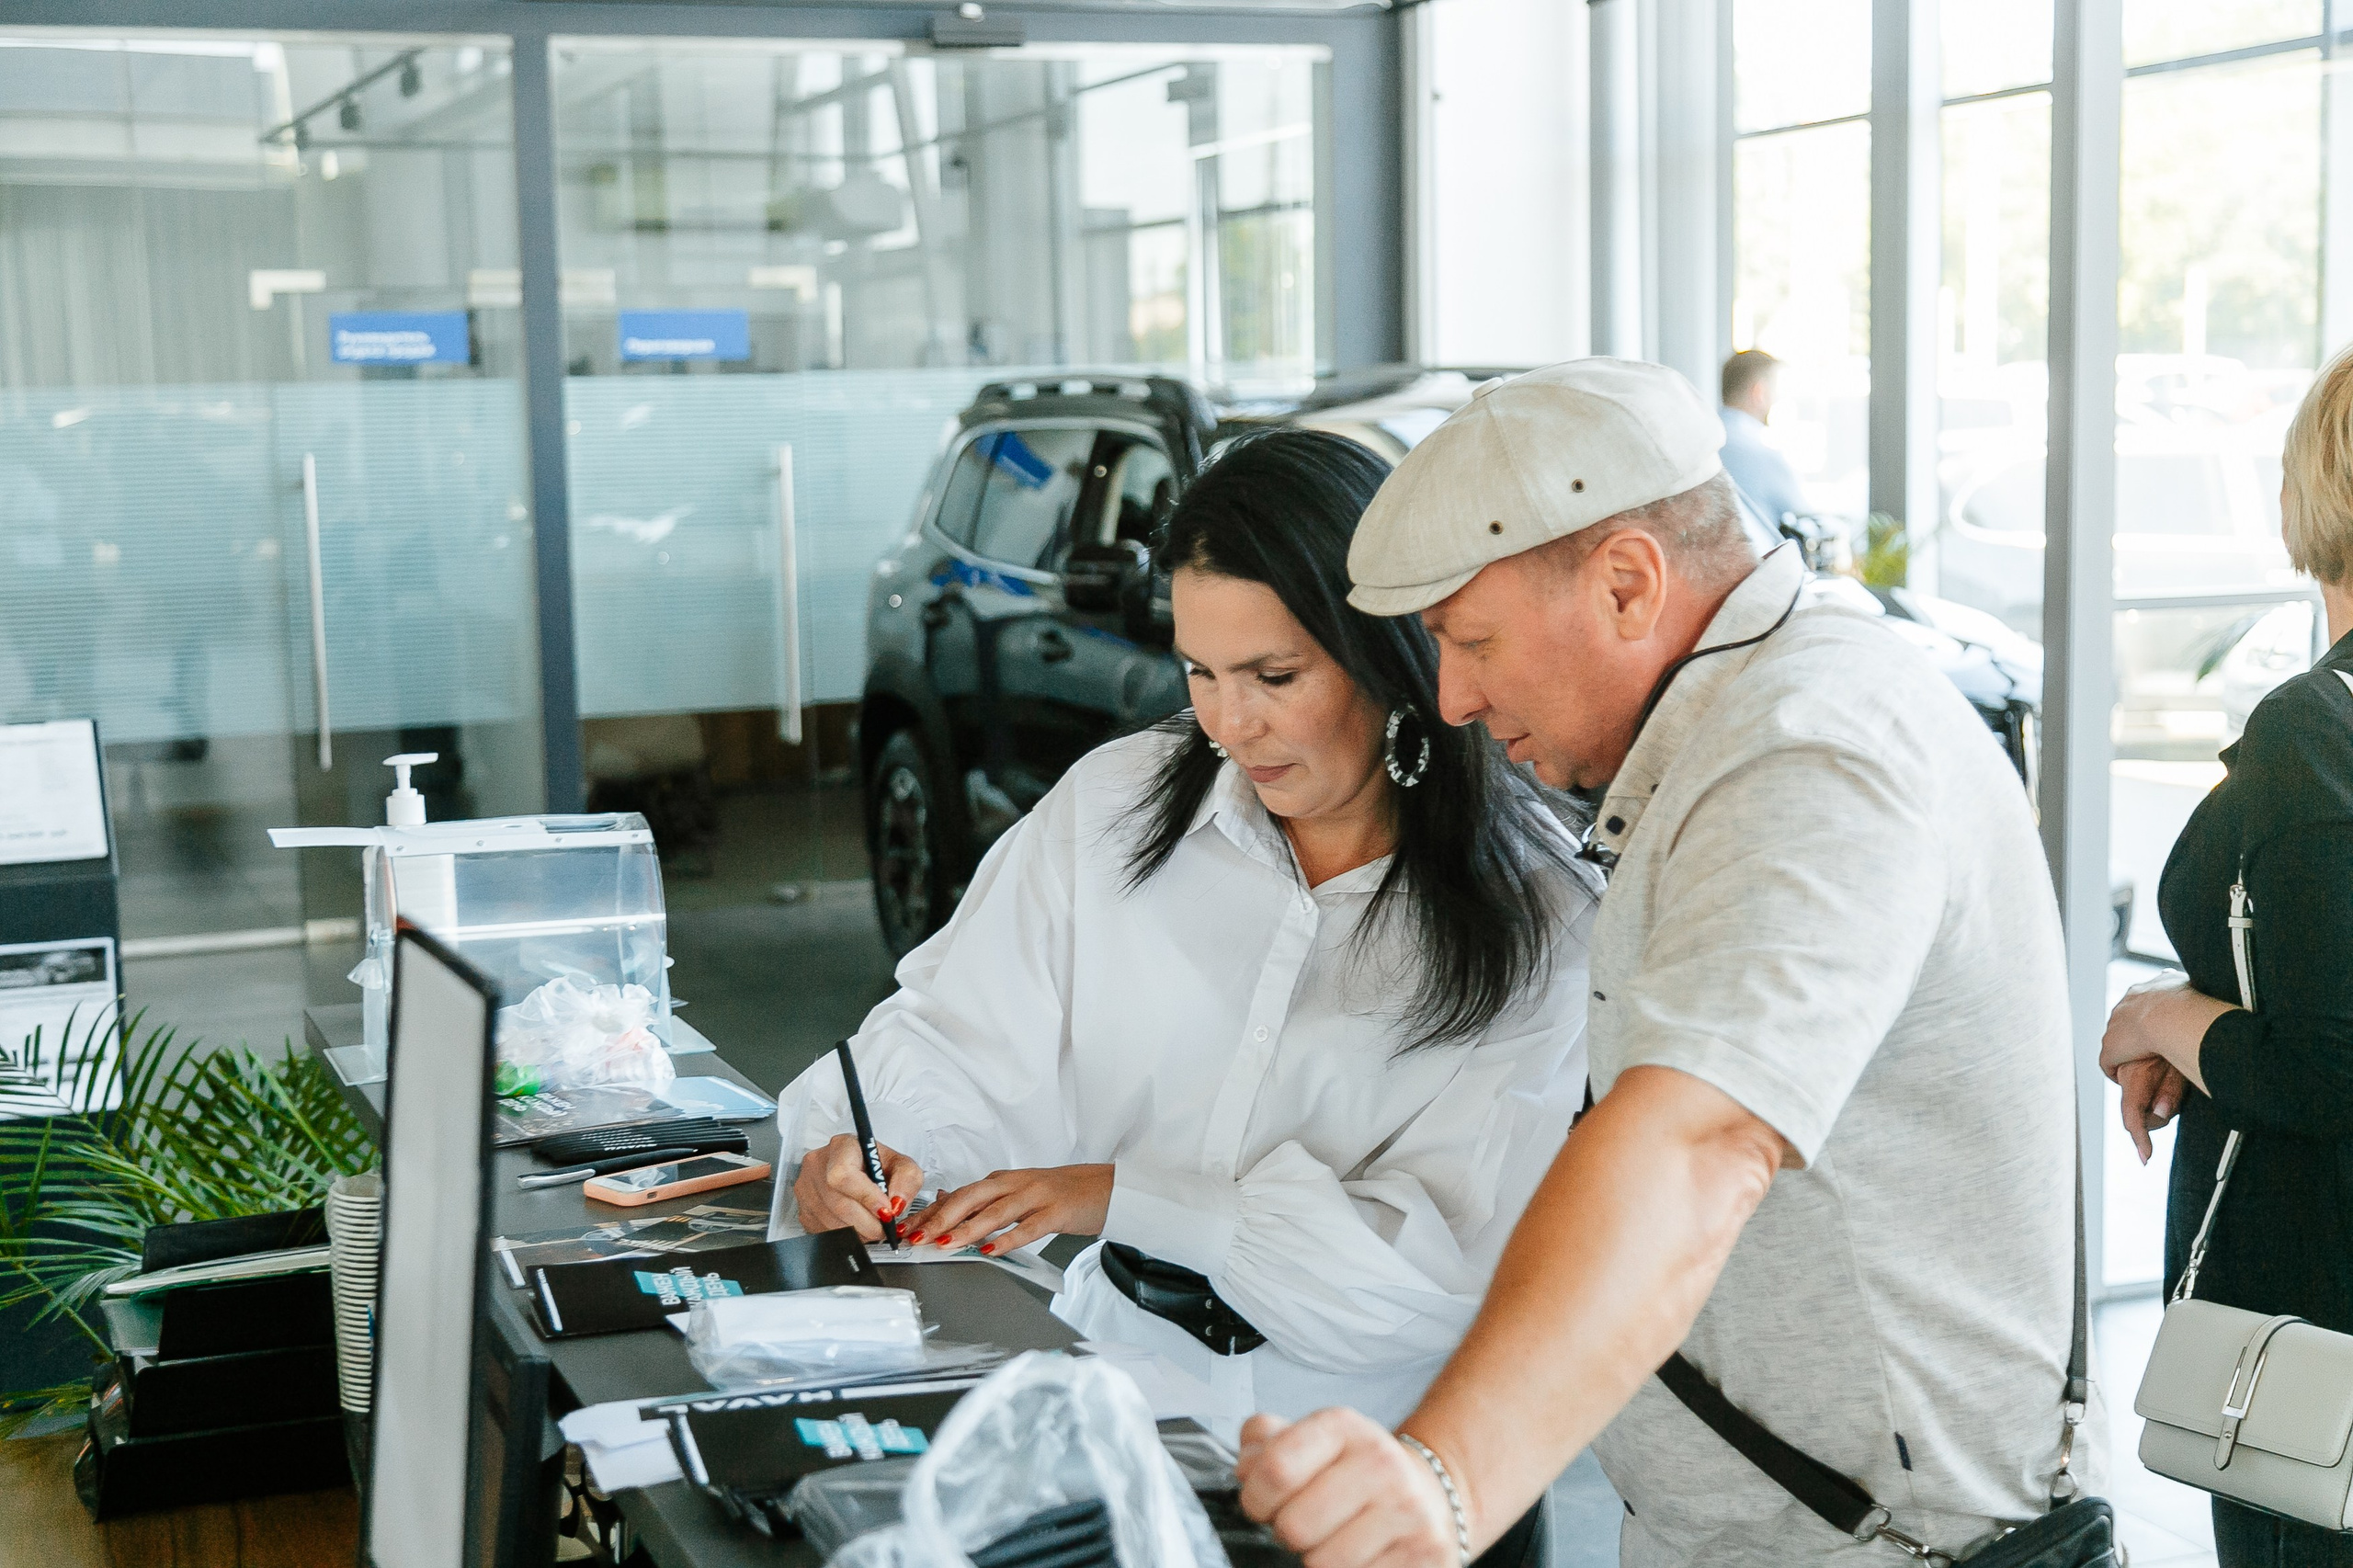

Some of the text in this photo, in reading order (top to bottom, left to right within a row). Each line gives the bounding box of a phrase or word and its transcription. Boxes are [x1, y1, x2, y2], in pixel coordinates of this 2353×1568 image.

[866, 1137, 888, 1194] HAVAL
[652, 1272, 682, 1305] ВАЖЕН
[701, 1272, 732, 1297] ДЕНЬ
